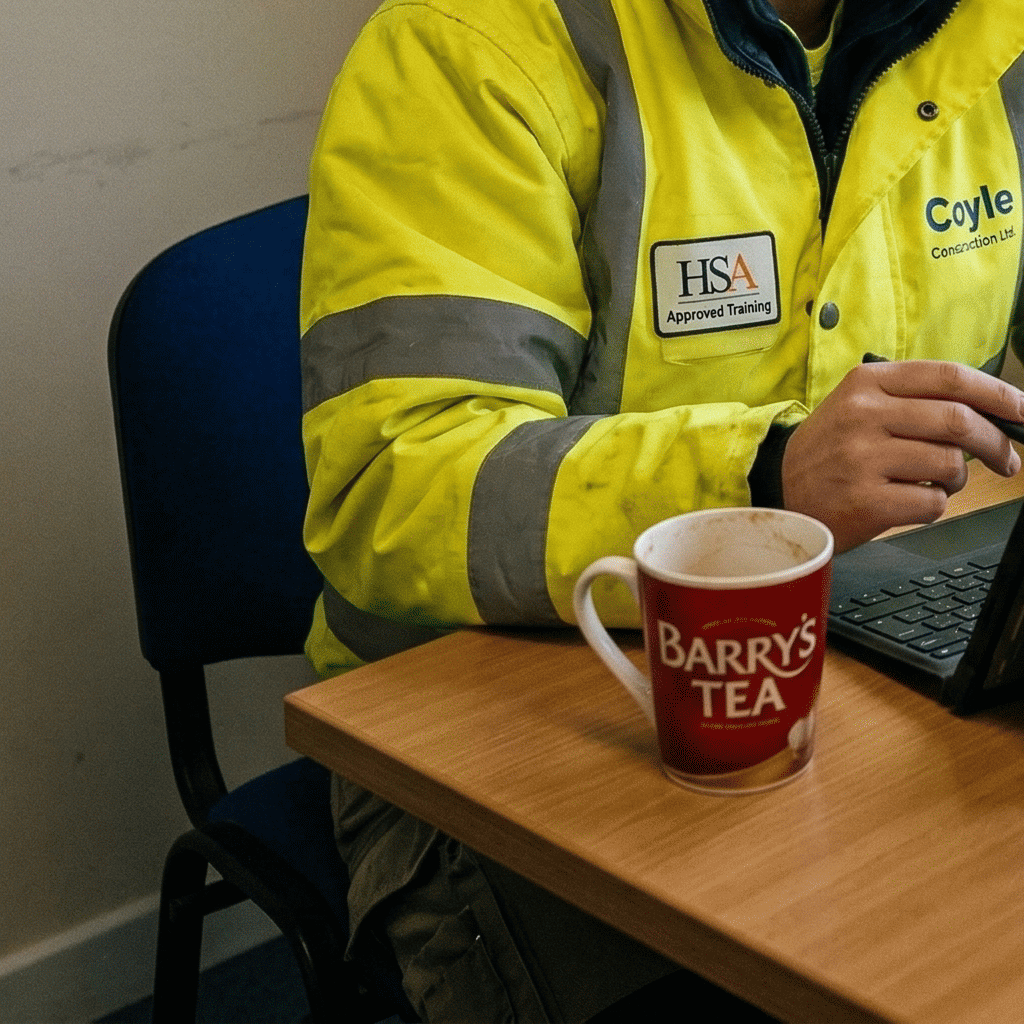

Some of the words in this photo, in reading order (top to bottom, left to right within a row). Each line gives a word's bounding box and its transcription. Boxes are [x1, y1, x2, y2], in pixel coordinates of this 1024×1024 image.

[926, 185, 1014, 233] Coyle
[676, 253, 759, 297] HSA
[666, 305, 724, 325] Approved
[727, 300, 772, 316] Training
[691, 676, 787, 719] TEA
